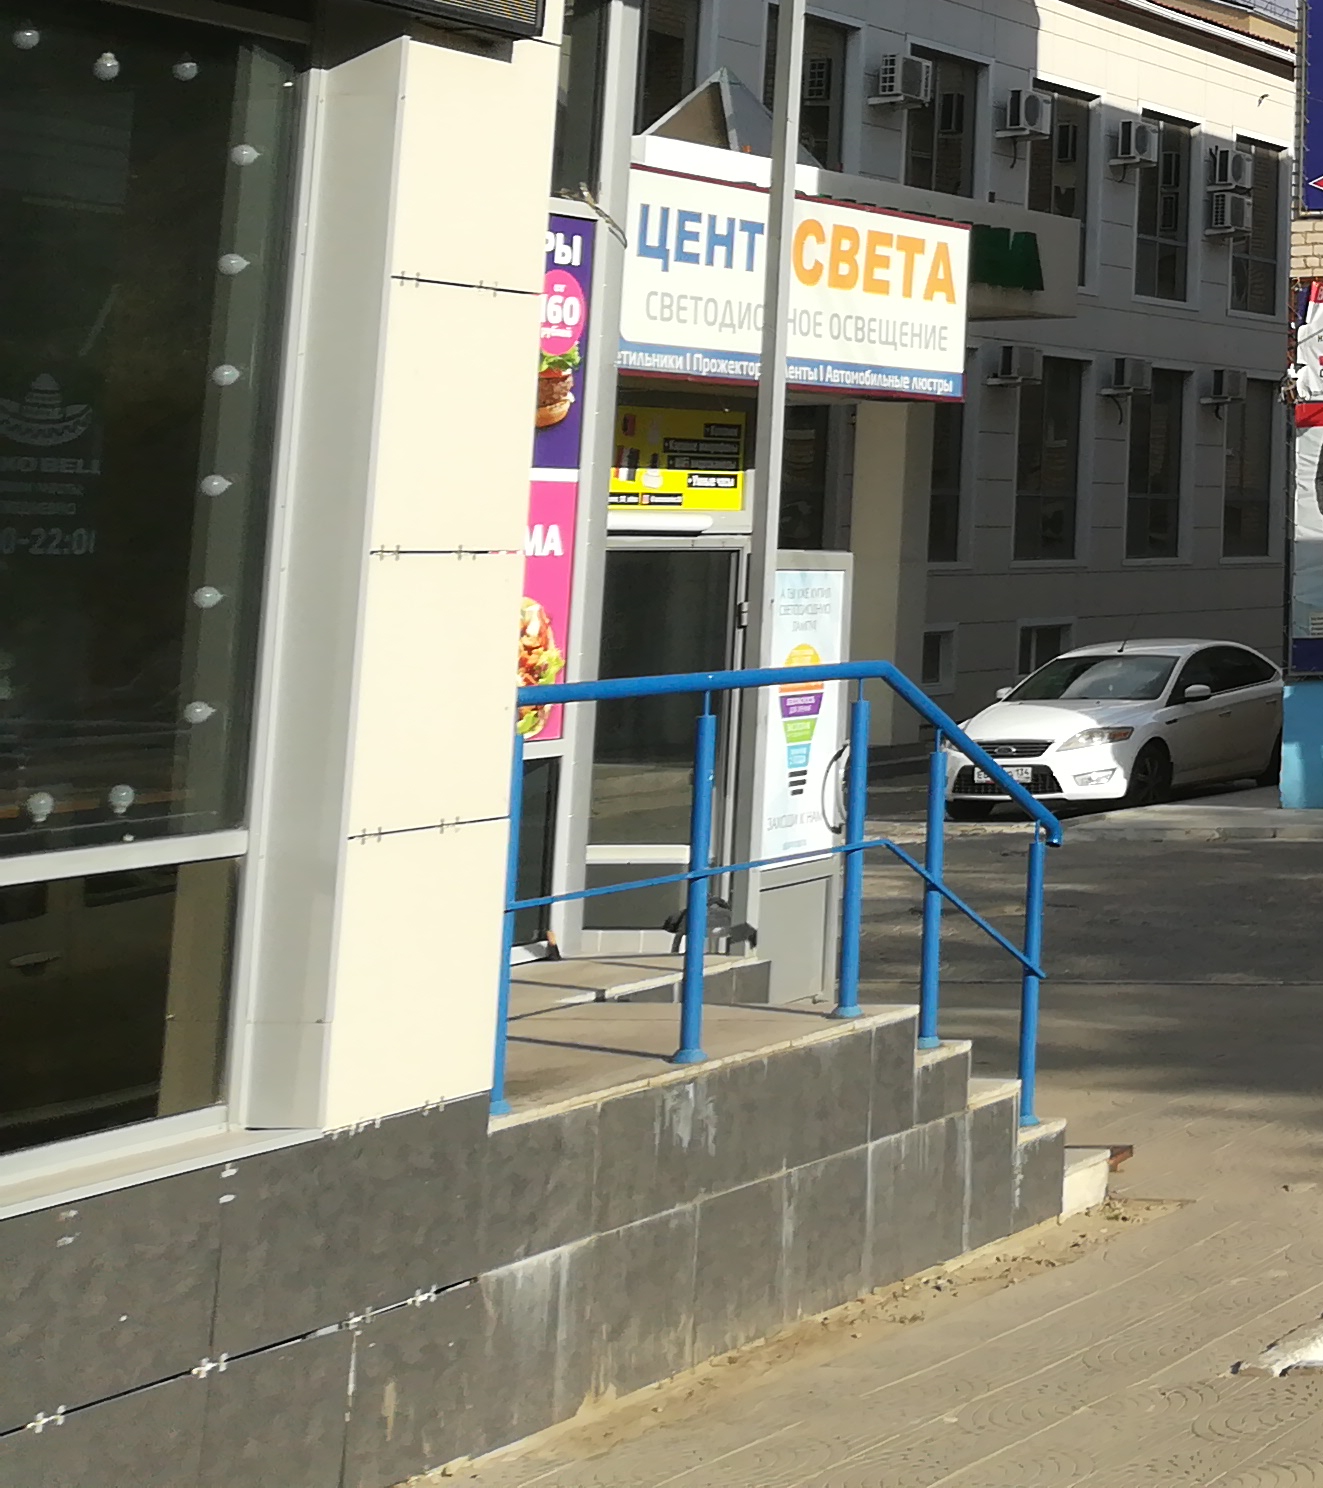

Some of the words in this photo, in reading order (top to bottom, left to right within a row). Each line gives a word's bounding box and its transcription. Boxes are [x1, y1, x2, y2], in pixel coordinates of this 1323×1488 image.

[636, 202, 764, 272] ЦЕНТ
[791, 218, 957, 305] СВЕТА
[828, 315, 949, 353] ОСВЕЩЕНИЕ
[694, 353, 761, 380] Прожектор
[825, 364, 910, 391] Автомобильные
